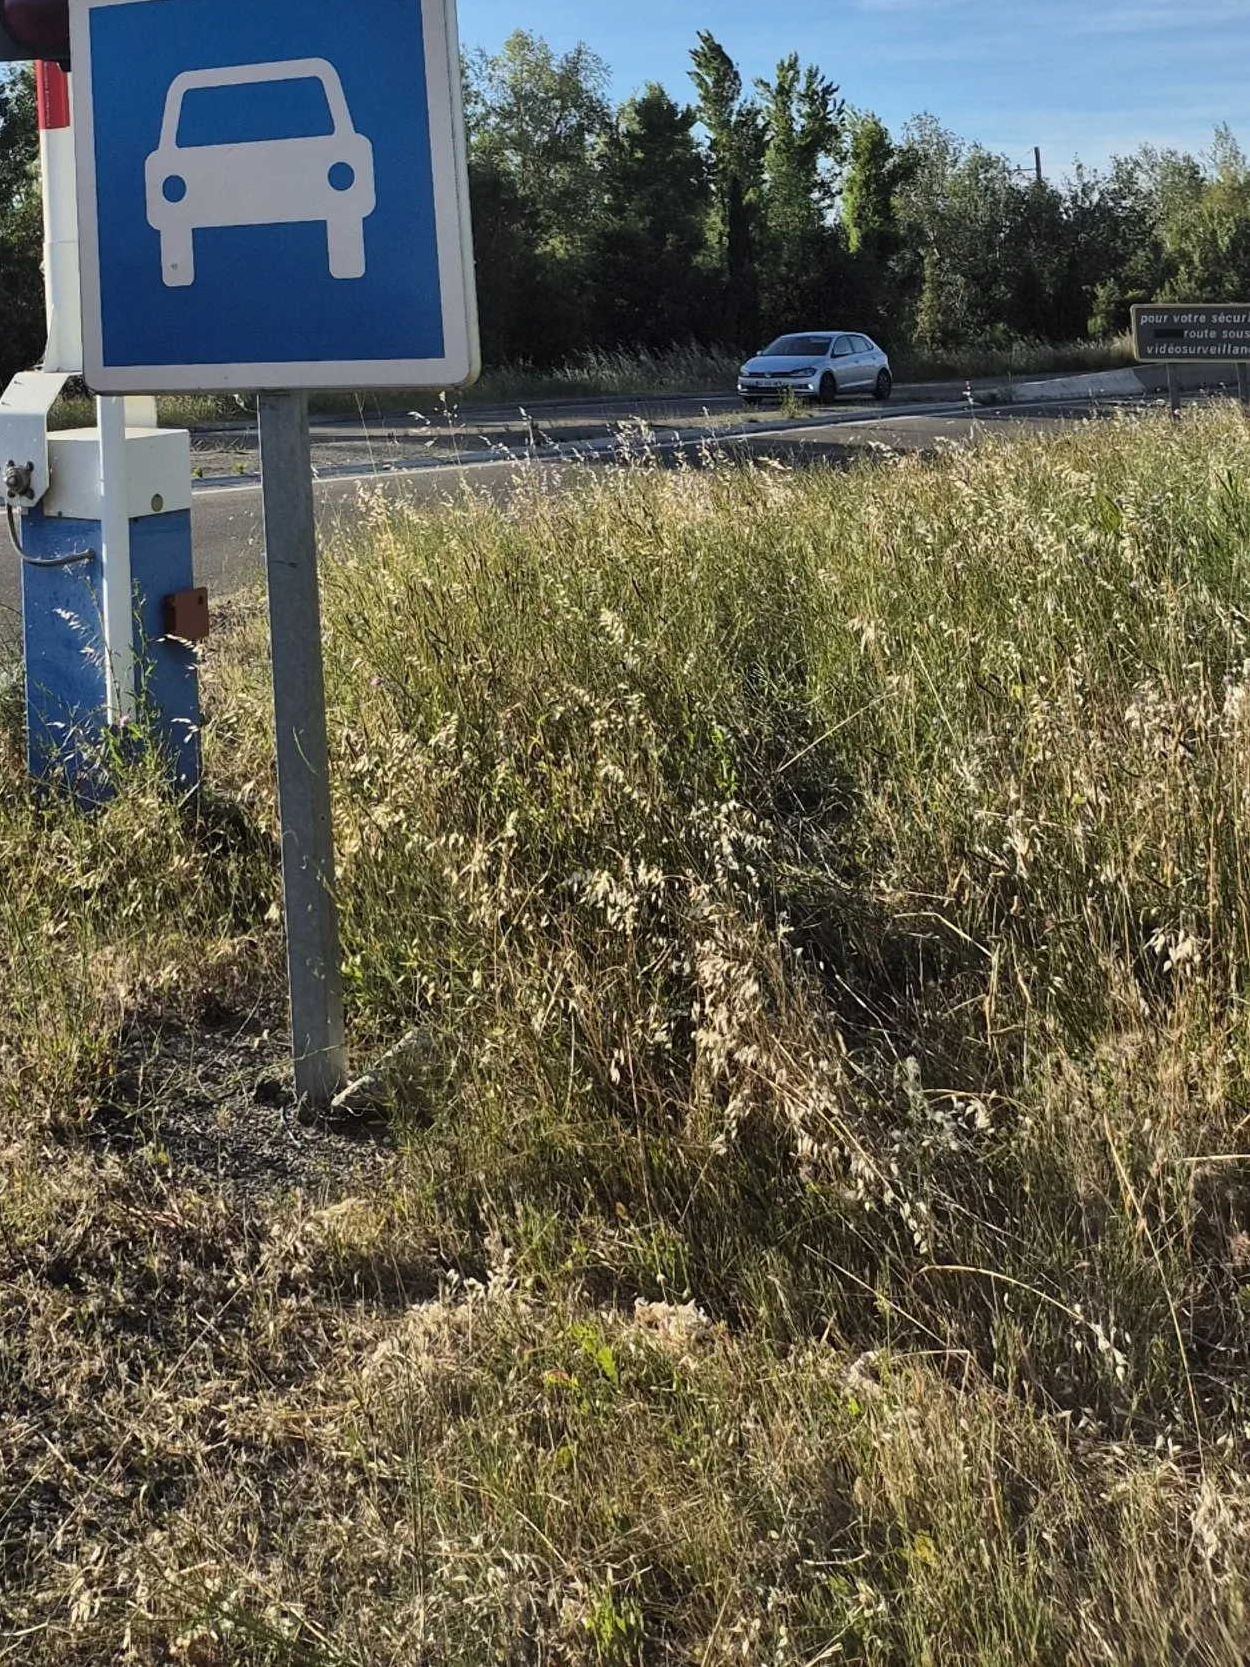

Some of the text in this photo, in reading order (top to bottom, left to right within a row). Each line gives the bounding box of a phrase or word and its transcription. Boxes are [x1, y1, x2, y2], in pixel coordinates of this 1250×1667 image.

[1140, 314, 1168, 325] pour
[1173, 313, 1206, 323] votre
[1183, 329, 1250, 339] route sous
